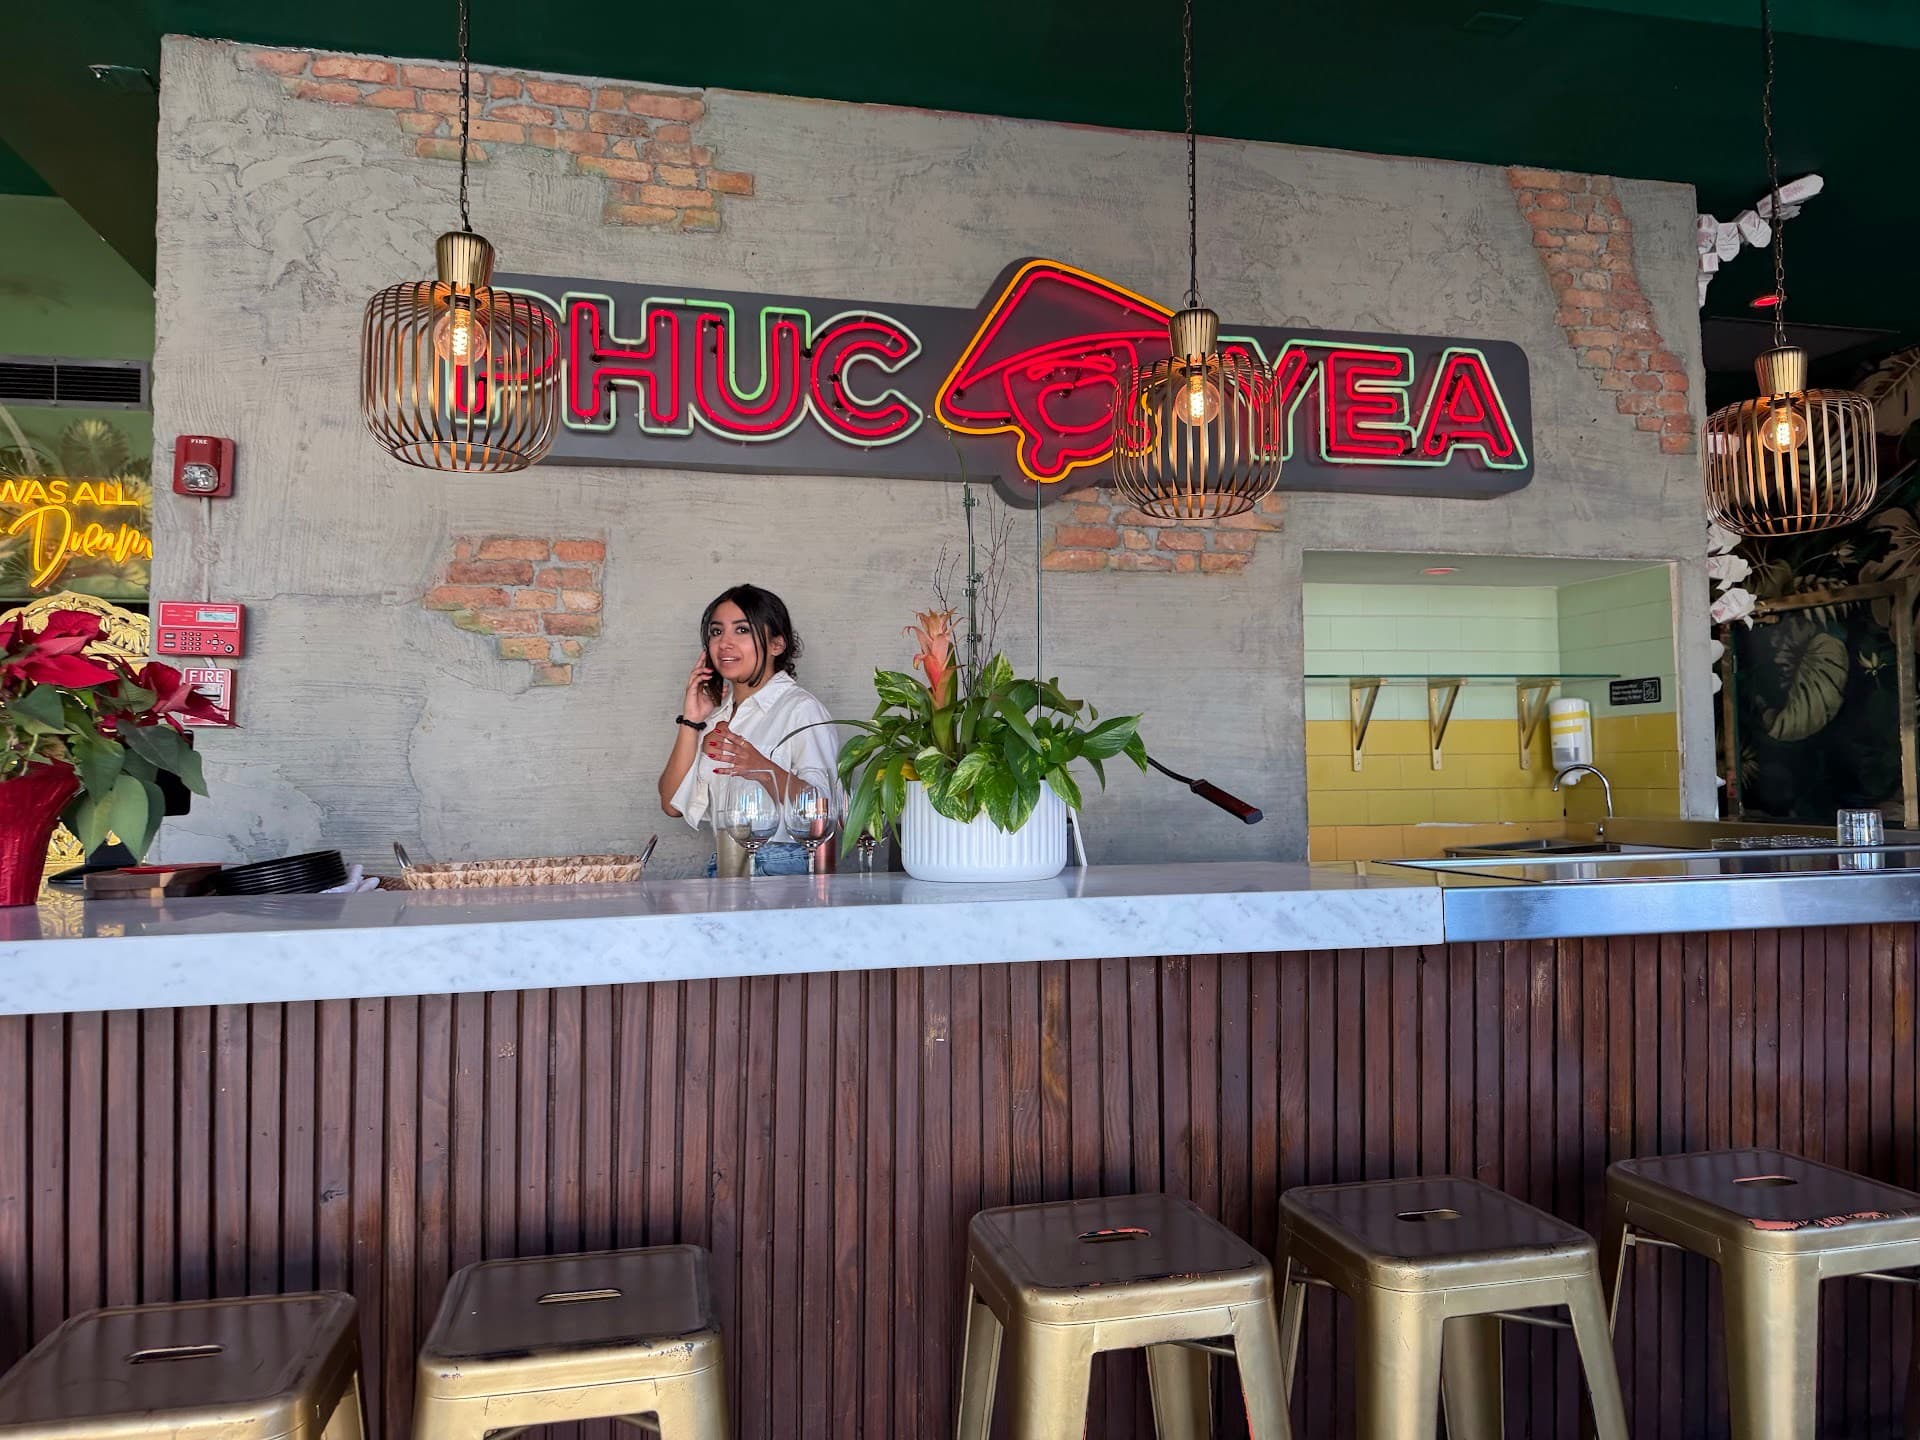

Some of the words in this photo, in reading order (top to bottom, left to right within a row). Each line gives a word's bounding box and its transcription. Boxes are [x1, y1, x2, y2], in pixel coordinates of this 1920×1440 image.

[1216, 335, 1528, 469] YEA
[72, 481, 139, 506] ALL
[189, 670, 225, 683] FIRE
